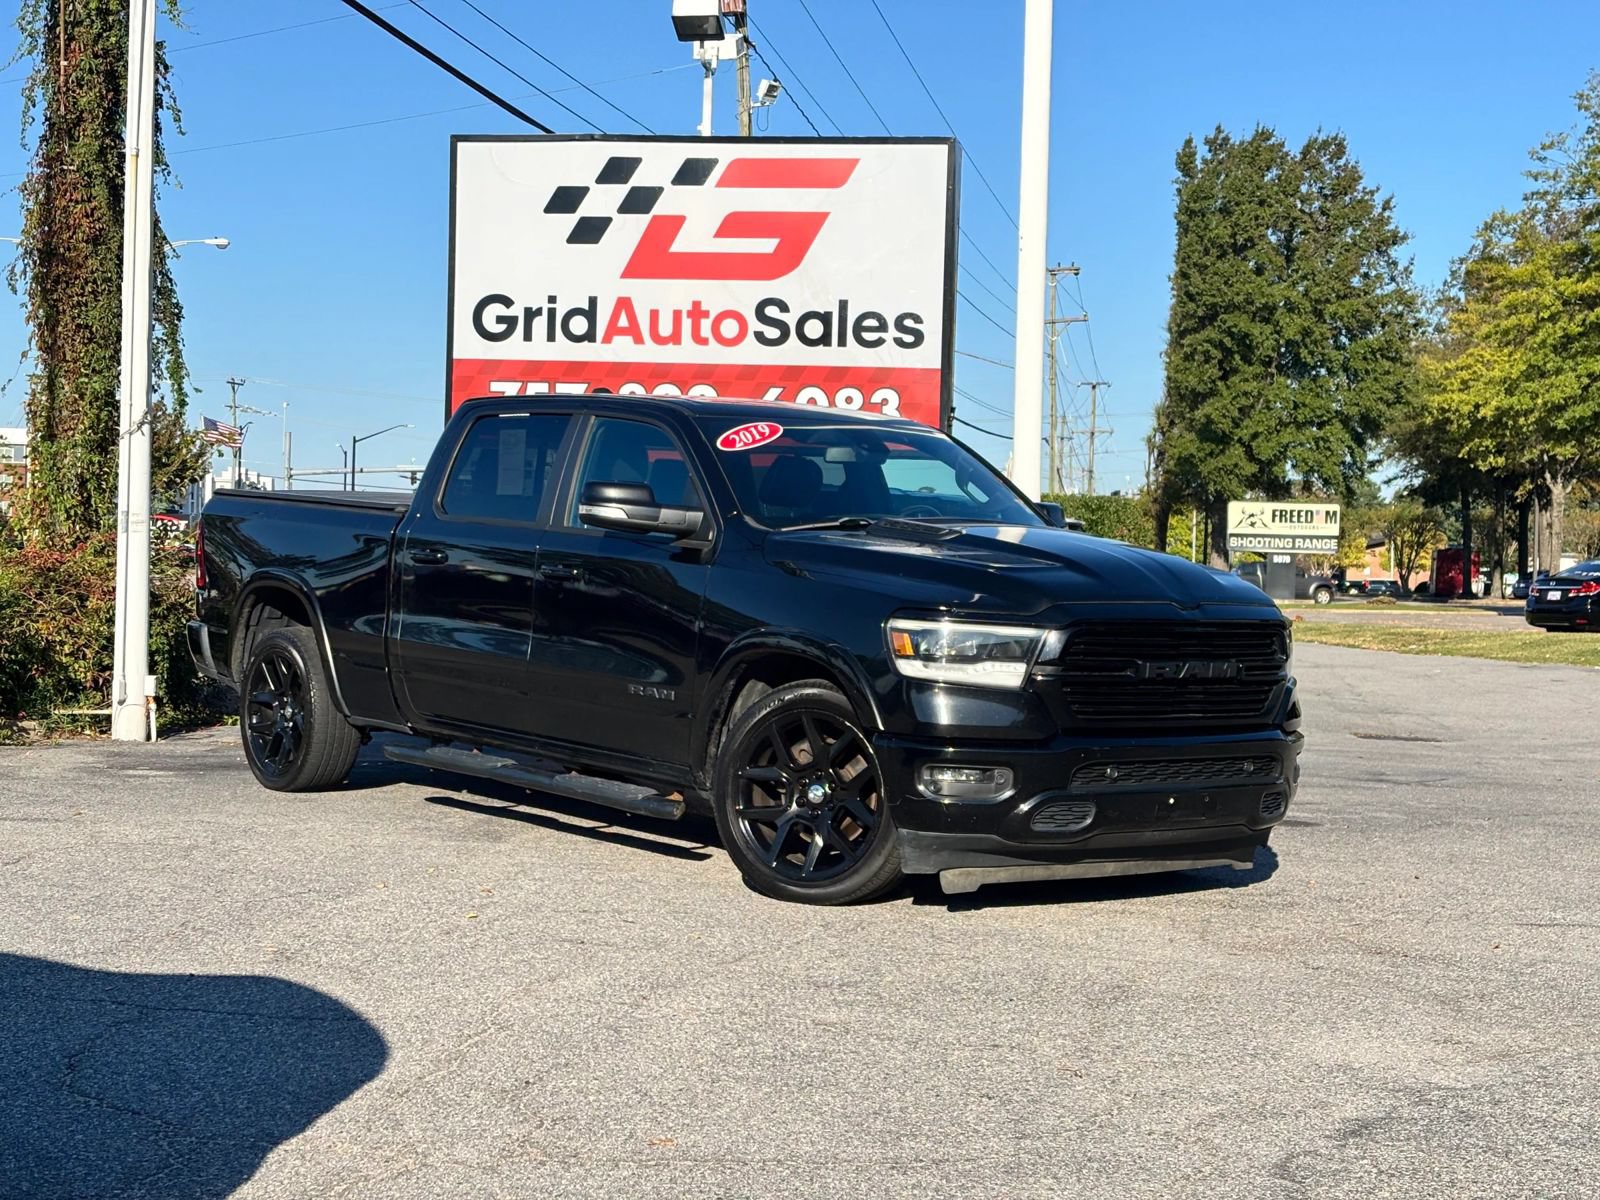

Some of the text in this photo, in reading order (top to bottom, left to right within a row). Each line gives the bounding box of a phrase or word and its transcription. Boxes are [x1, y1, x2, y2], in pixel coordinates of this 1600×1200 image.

[472, 293, 925, 350] GridAutoSales
[729, 423, 770, 449] 2019
[1229, 536, 1338, 550] SHOOTING RANGE
[1144, 661, 1238, 679] RAM
[627, 684, 675, 701] RAM
